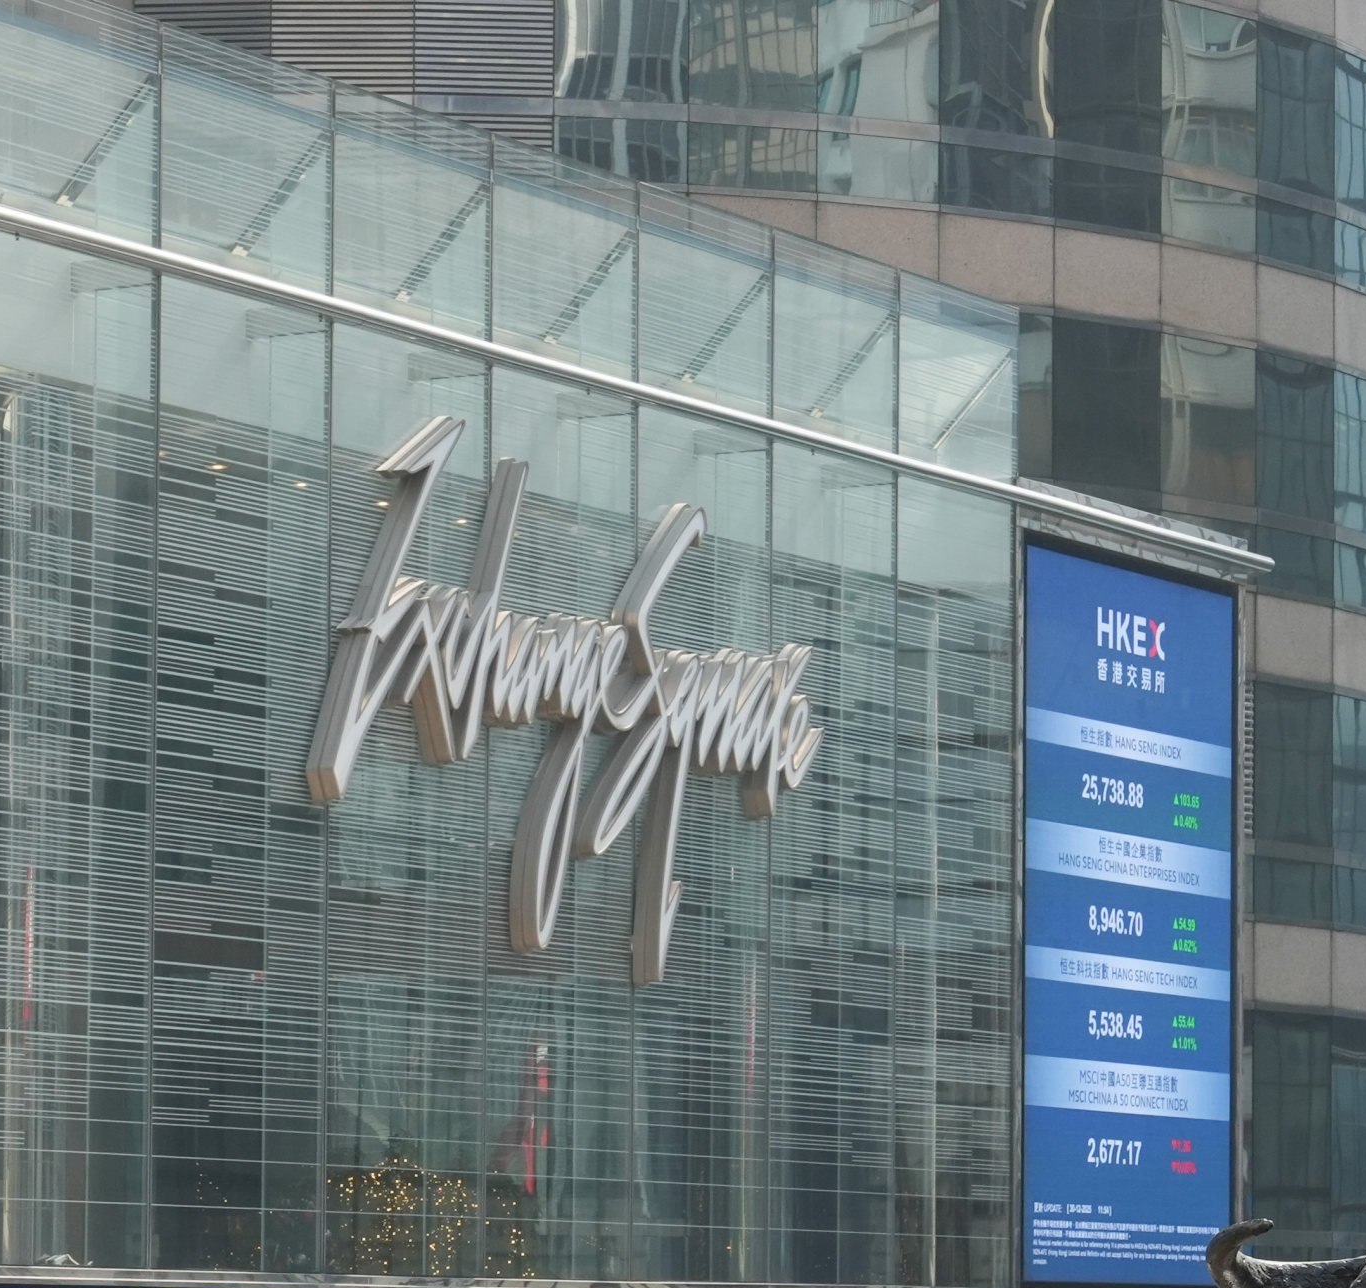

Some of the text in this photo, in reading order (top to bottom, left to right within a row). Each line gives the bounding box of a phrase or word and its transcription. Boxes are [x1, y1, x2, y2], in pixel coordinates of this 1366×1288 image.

[1098, 607, 1165, 660] HKEX
[1097, 659, 1165, 693] 香港交易所
[1080, 726, 1181, 761] 恒生指數 HANG SENG INDEX
[1082, 774, 1143, 808] 25,738.88
[1179, 793, 1200, 809] 103.65
[1098, 840, 1162, 862] 恒生中國企業指數
[1058, 850, 1201, 887] HANG SENG CHINA ENTERPRISES INDEX
[1089, 905, 1143, 936] 8,946.70
[1178, 917, 1196, 932] 54.99
[1060, 959, 1198, 990] 恒生科技指數 HANG SENG TECH INDEX
[1089, 1010, 1142, 1039] 5,538.45
[1178, 1015, 1196, 1029] 55.44
[1178, 1035, 1198, 1051] 1.01%
[1068, 1090, 1189, 1112] MSCI CHINA A 50 CONNECT INDEX
[1088, 1138, 1141, 1167] 2,677.17
